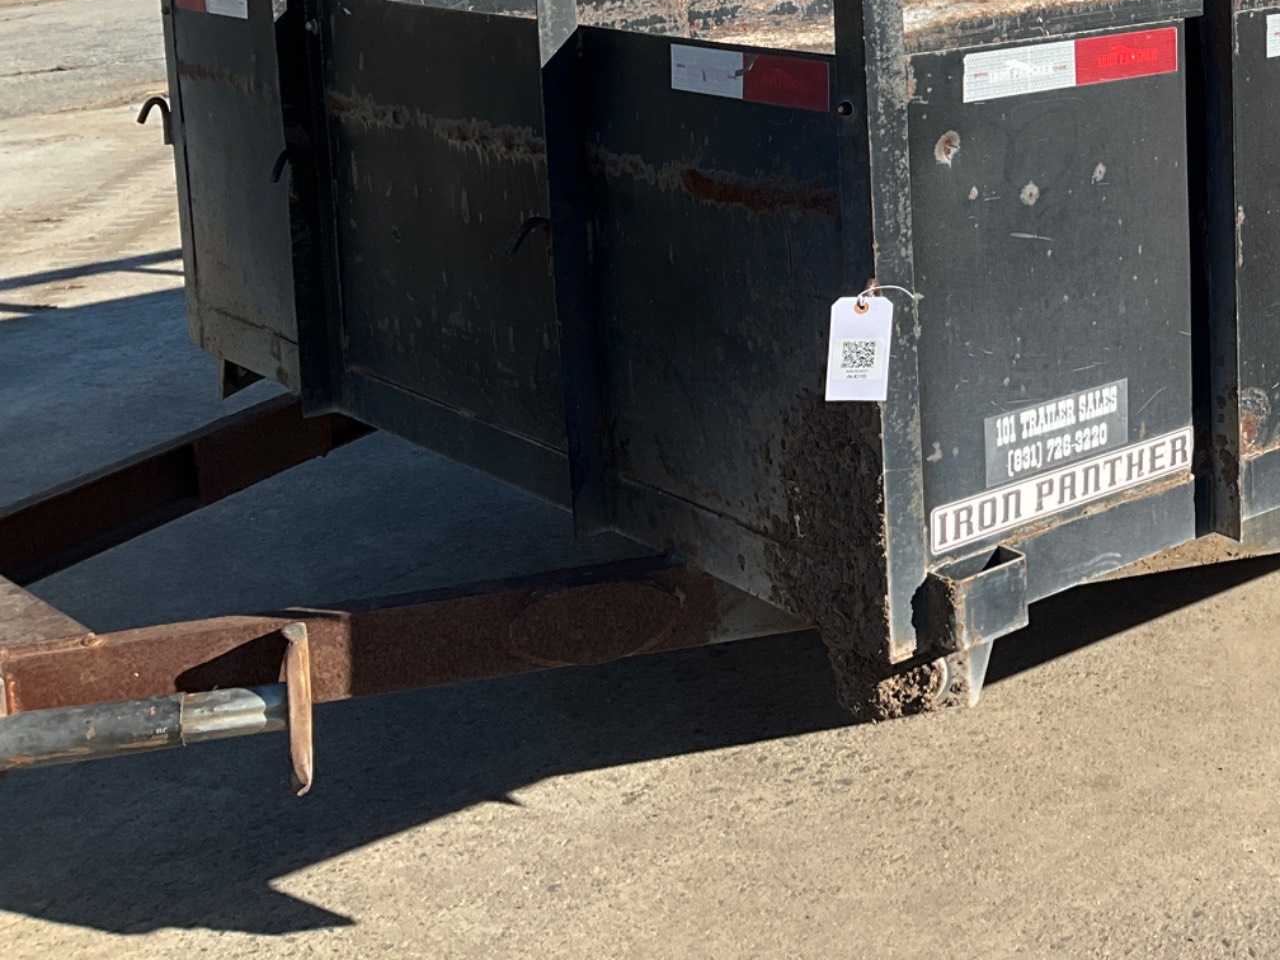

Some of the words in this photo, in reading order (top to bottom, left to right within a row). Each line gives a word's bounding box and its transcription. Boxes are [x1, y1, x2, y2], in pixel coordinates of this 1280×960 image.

[996, 415, 1016, 447] 101
[1020, 399, 1076, 439] TRAILER
[1079, 385, 1118, 422] SALES
[938, 489, 1022, 546] IRON
[1034, 433, 1189, 513] PANTHER
[1007, 441, 1042, 477] (831)
